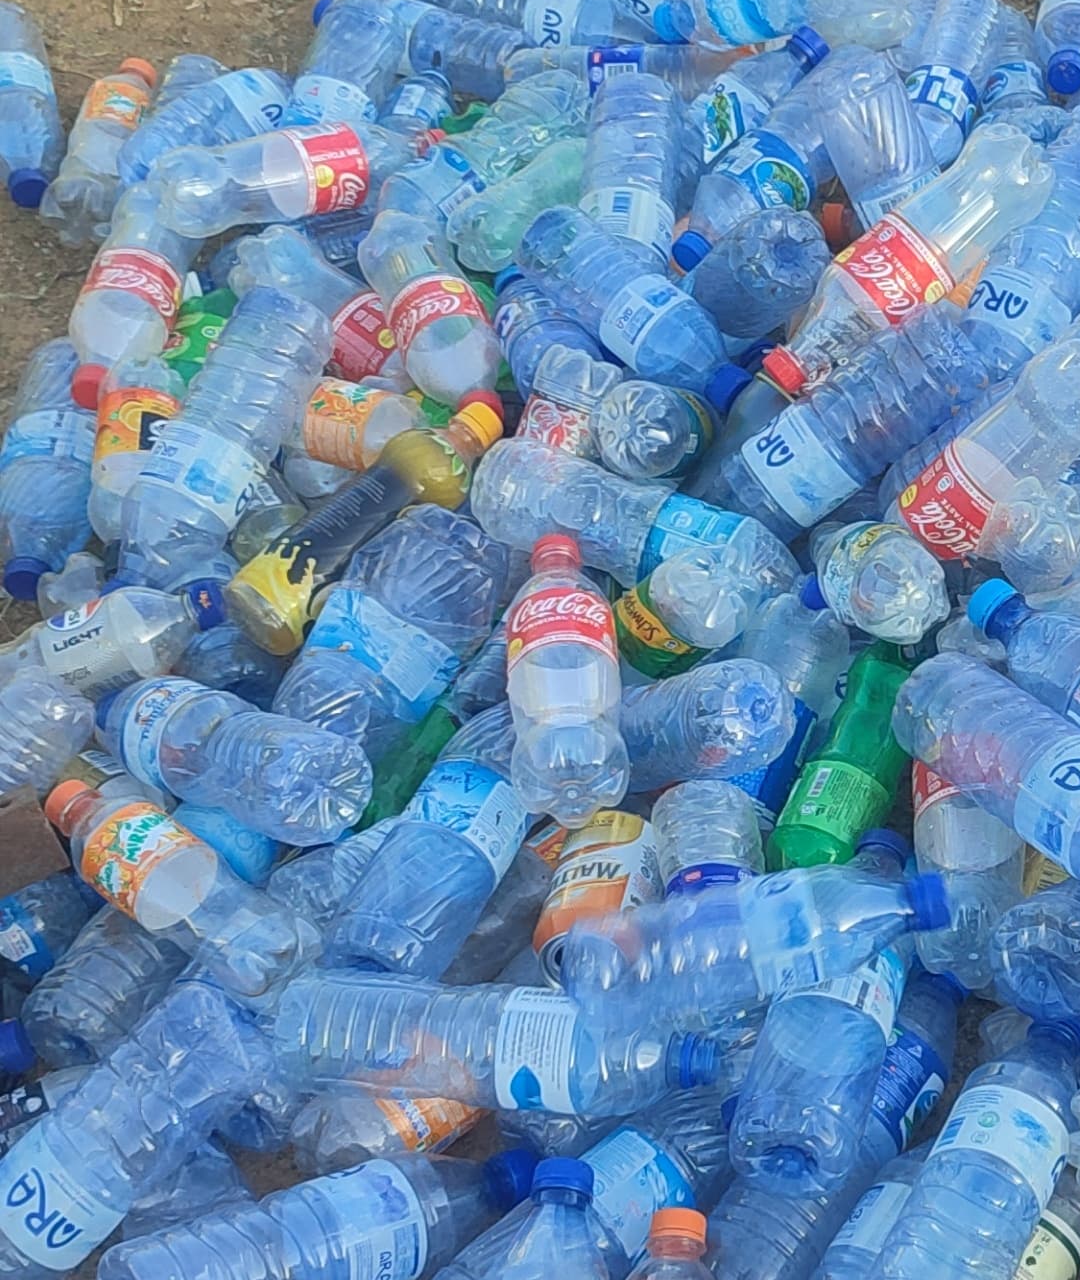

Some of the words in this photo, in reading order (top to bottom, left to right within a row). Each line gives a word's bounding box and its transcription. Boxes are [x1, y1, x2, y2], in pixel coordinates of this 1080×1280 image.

[540, 8, 563, 48] AR
[848, 239, 919, 316] Coca-Cola
[755, 425, 796, 469] AR
[511, 592, 608, 633] Coca-Cola
[6, 1166, 84, 1251] ARA
